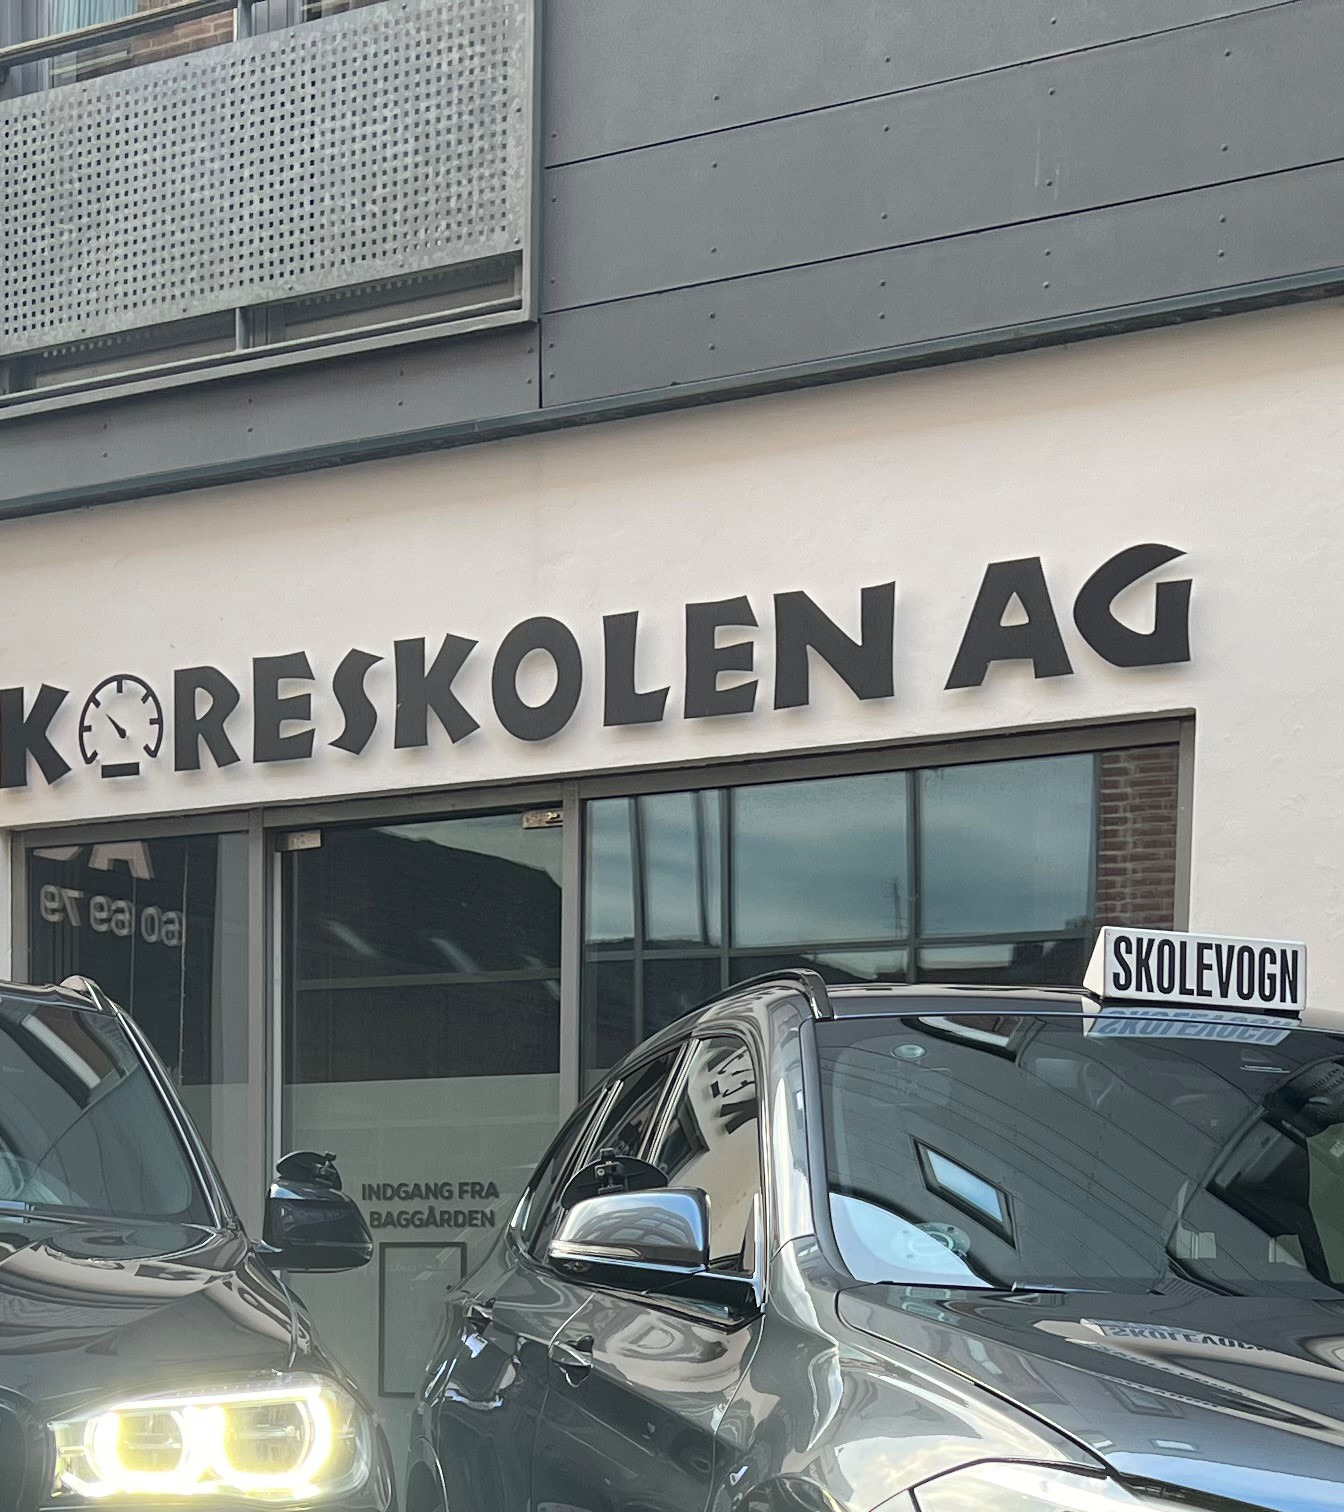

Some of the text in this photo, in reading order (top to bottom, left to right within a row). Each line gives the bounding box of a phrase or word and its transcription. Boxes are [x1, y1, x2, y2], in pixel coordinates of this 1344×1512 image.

[944, 543, 1192, 690] AG
[1113, 935, 1299, 1004] SKOLEVOGN
[362, 1181, 500, 1201] INDGANG FRA
[369, 1205, 495, 1229] BAGGÅRDEN
